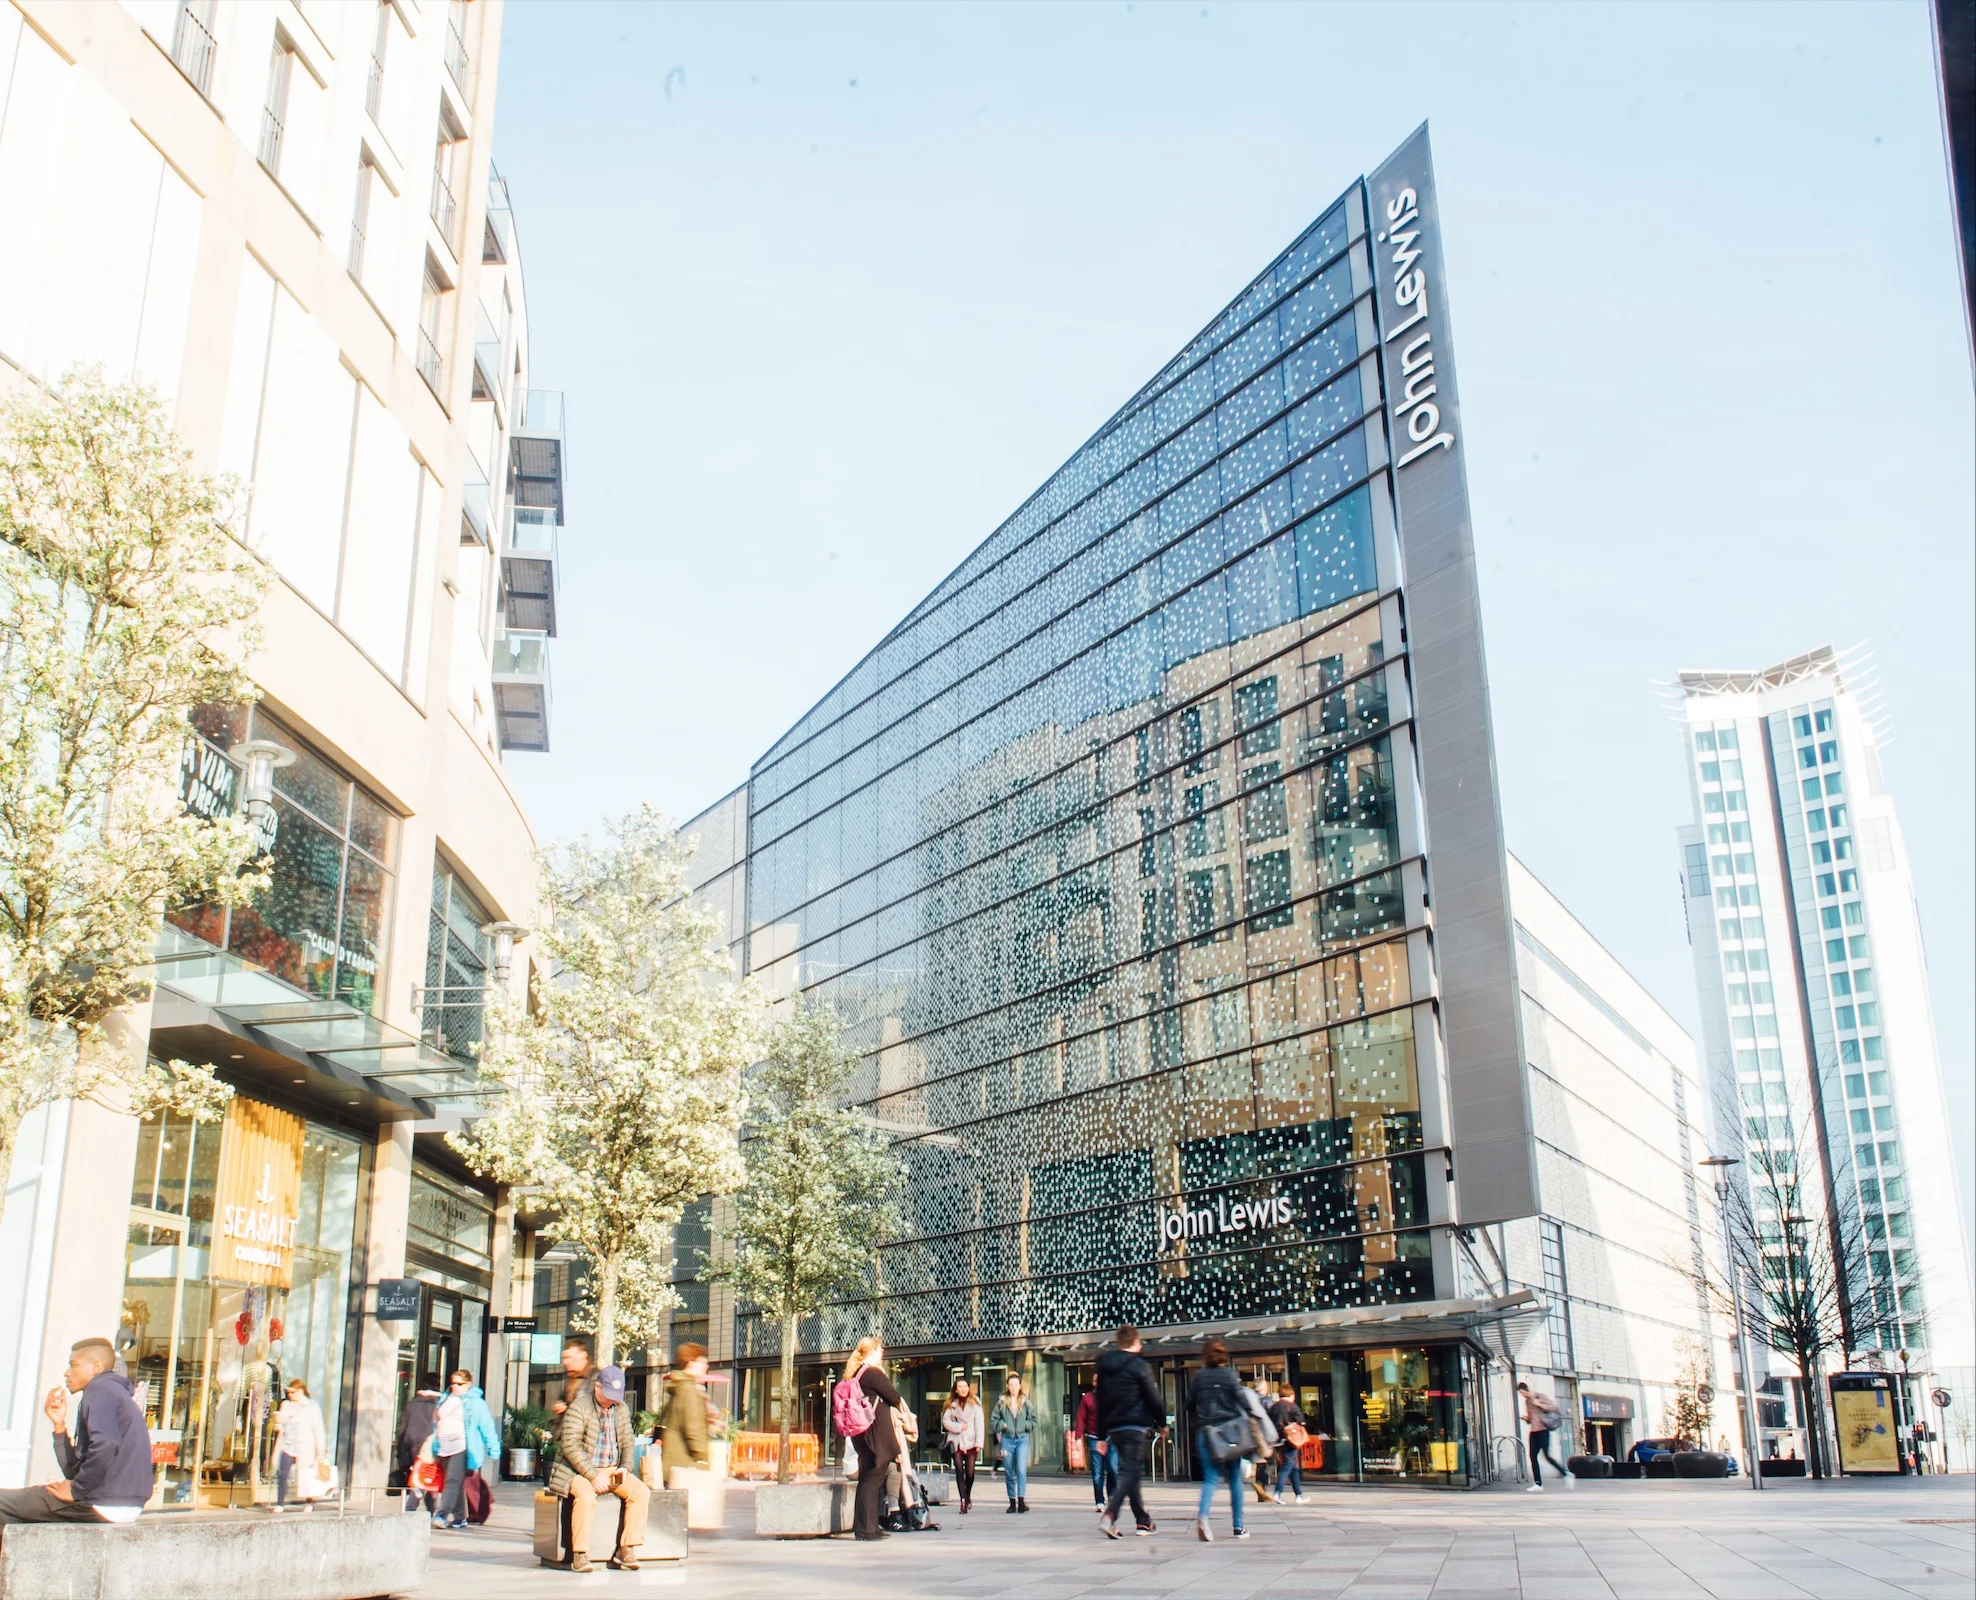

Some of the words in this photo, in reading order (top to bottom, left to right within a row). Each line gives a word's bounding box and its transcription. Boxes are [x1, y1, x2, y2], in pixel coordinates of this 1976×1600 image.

[1378, 187, 1430, 343] Lewis
[1395, 332, 1455, 469] John
[200, 744, 233, 803] VIDA
[223, 1204, 300, 1249] SEASALT
[1158, 1203, 1214, 1253] John
[1219, 1187, 1293, 1232] Lewis
[380, 1297, 416, 1306] SEASALT
